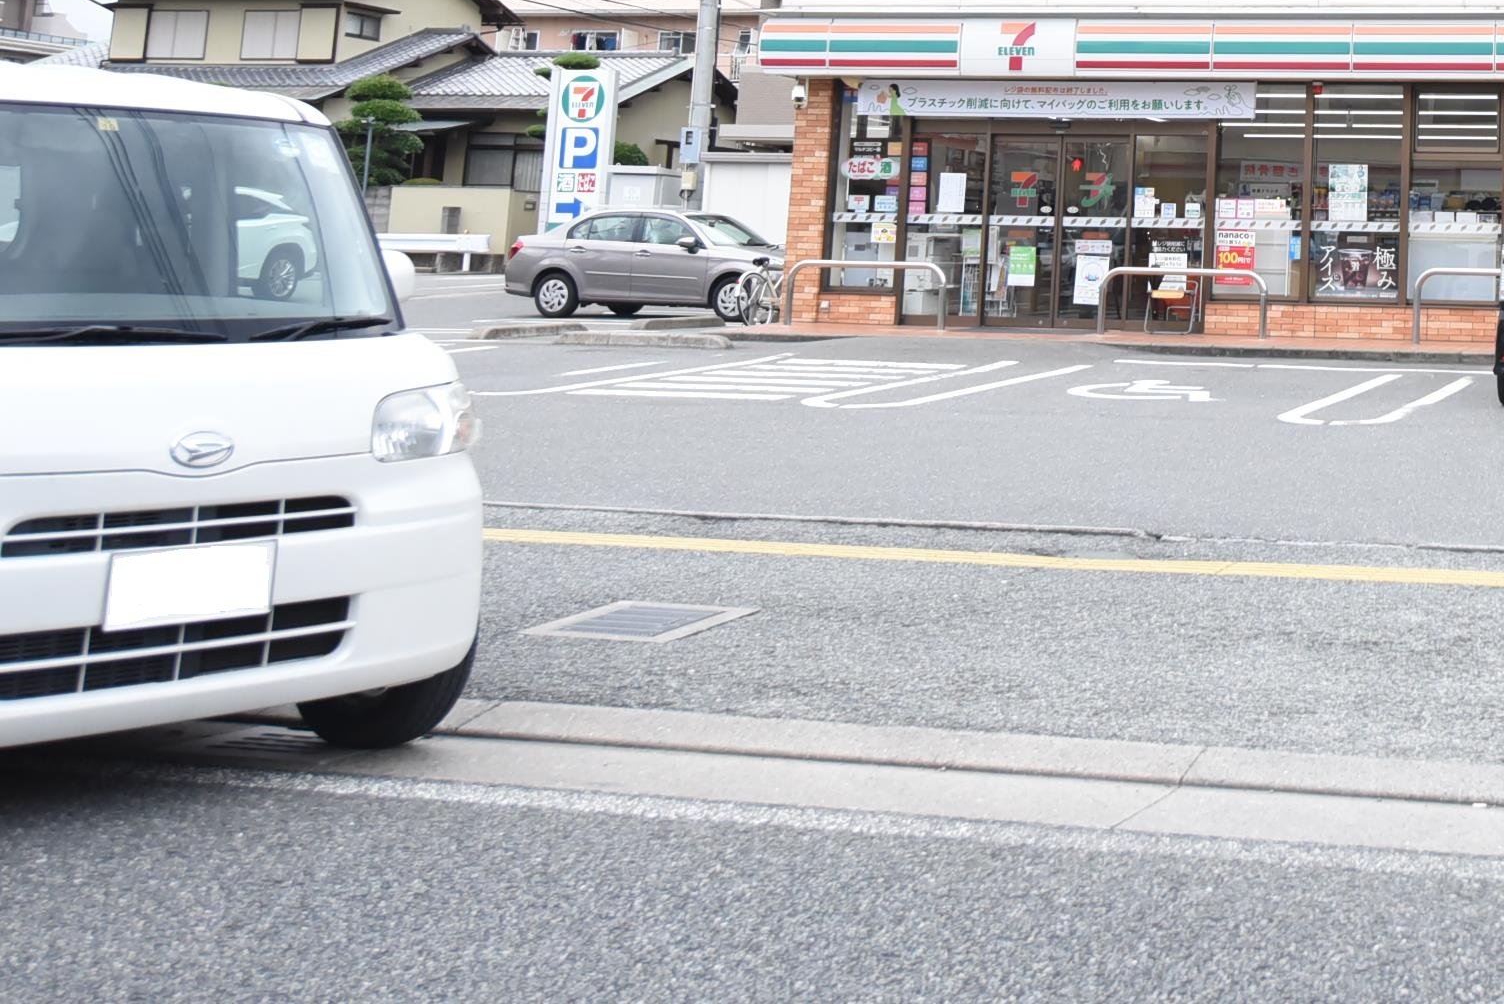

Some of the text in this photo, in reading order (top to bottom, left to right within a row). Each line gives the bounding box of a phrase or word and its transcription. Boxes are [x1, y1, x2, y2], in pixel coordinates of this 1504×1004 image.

[562, 128, 597, 168] P
[848, 161, 875, 174] たばこ
[1218, 232, 1250, 240] nanaco
[1318, 245, 1336, 291] アイス
[1373, 246, 1397, 290] 極み
